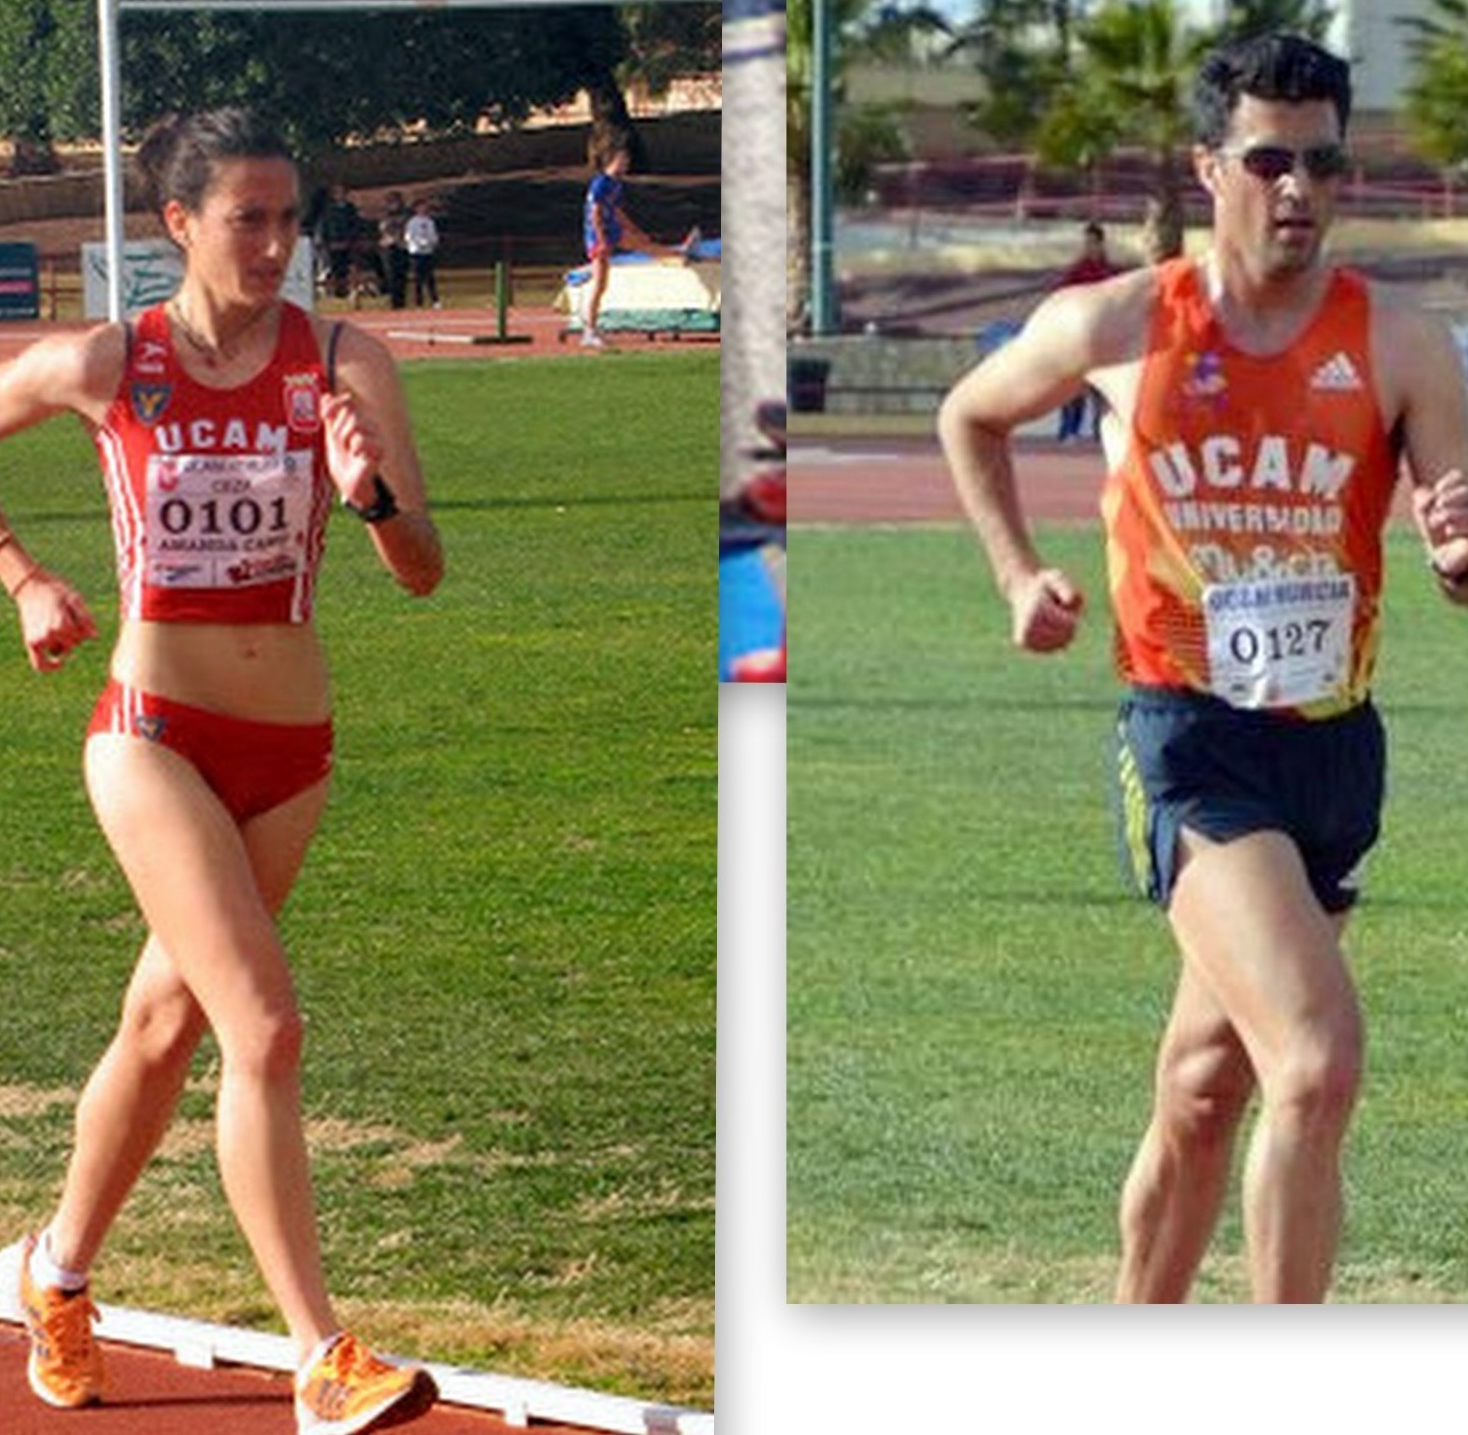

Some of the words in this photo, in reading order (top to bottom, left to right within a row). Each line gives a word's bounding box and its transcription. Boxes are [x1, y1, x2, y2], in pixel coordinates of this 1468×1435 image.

[155, 418, 289, 454] UCAM
[1149, 436, 1356, 499] UCAM
[159, 497, 288, 535] 0101
[1229, 619, 1331, 664] 0127
